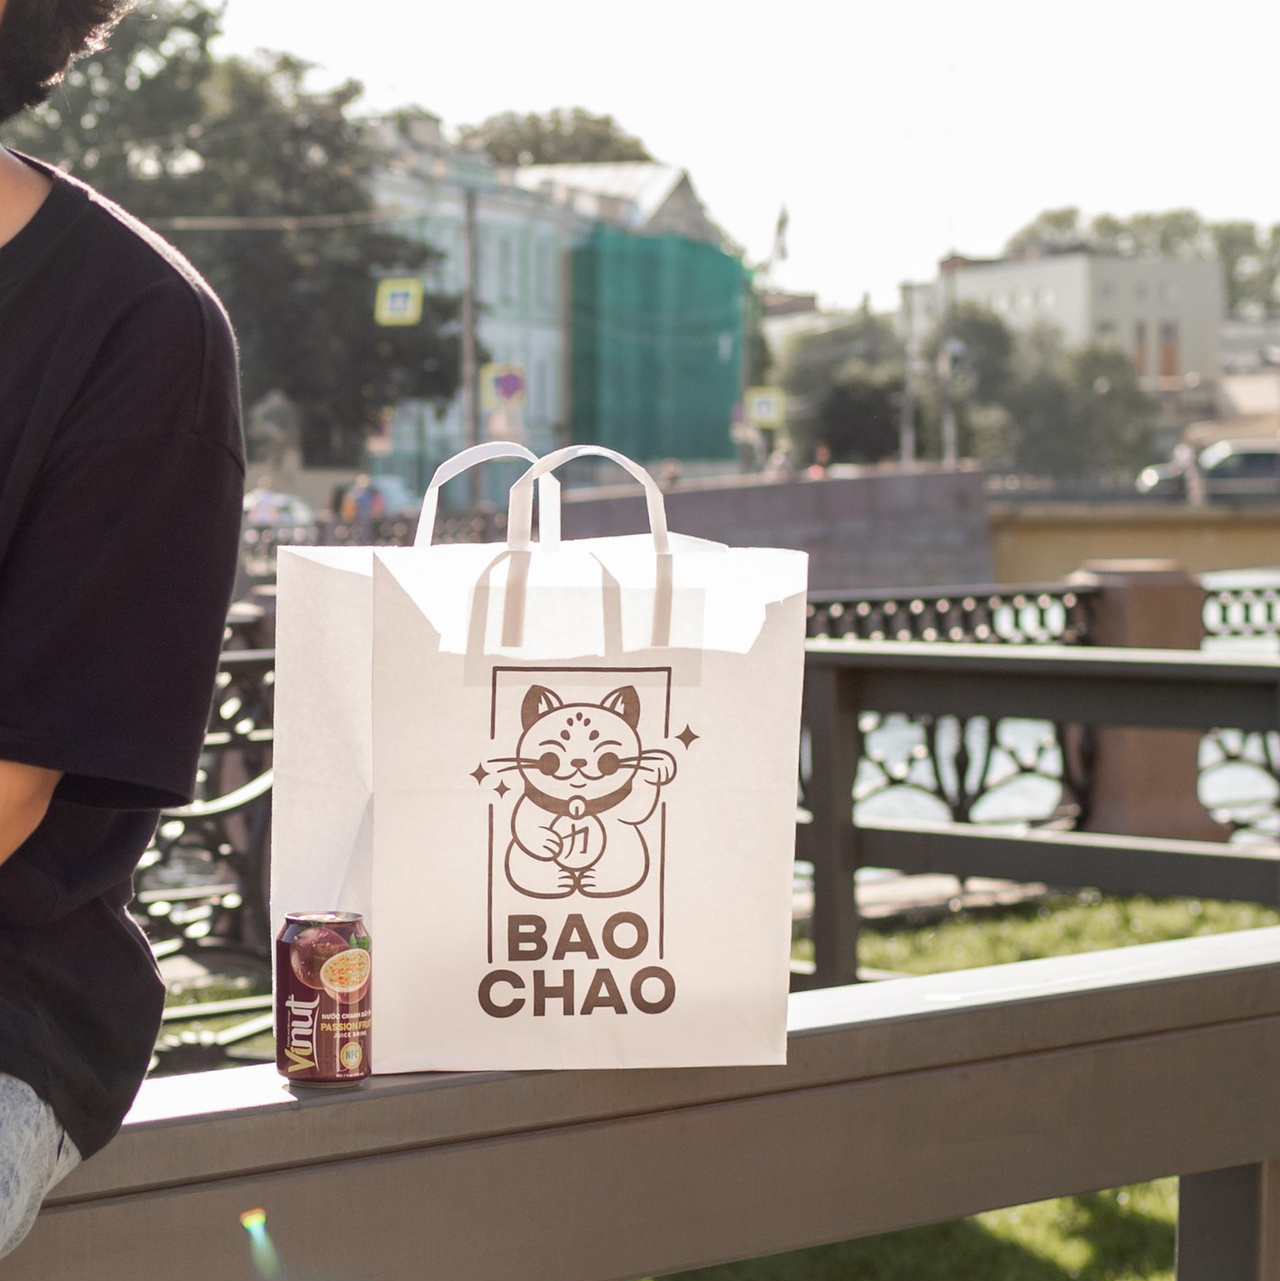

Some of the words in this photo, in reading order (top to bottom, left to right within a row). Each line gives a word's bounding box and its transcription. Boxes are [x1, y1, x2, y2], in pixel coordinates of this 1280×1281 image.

[562, 824, 589, 859] 力
[508, 911, 649, 961] BAO
[478, 966, 676, 1018] CHAO
[284, 994, 320, 1072] Vinut
[320, 1022, 358, 1031] PASSION
[346, 1050, 358, 1059] NFC
